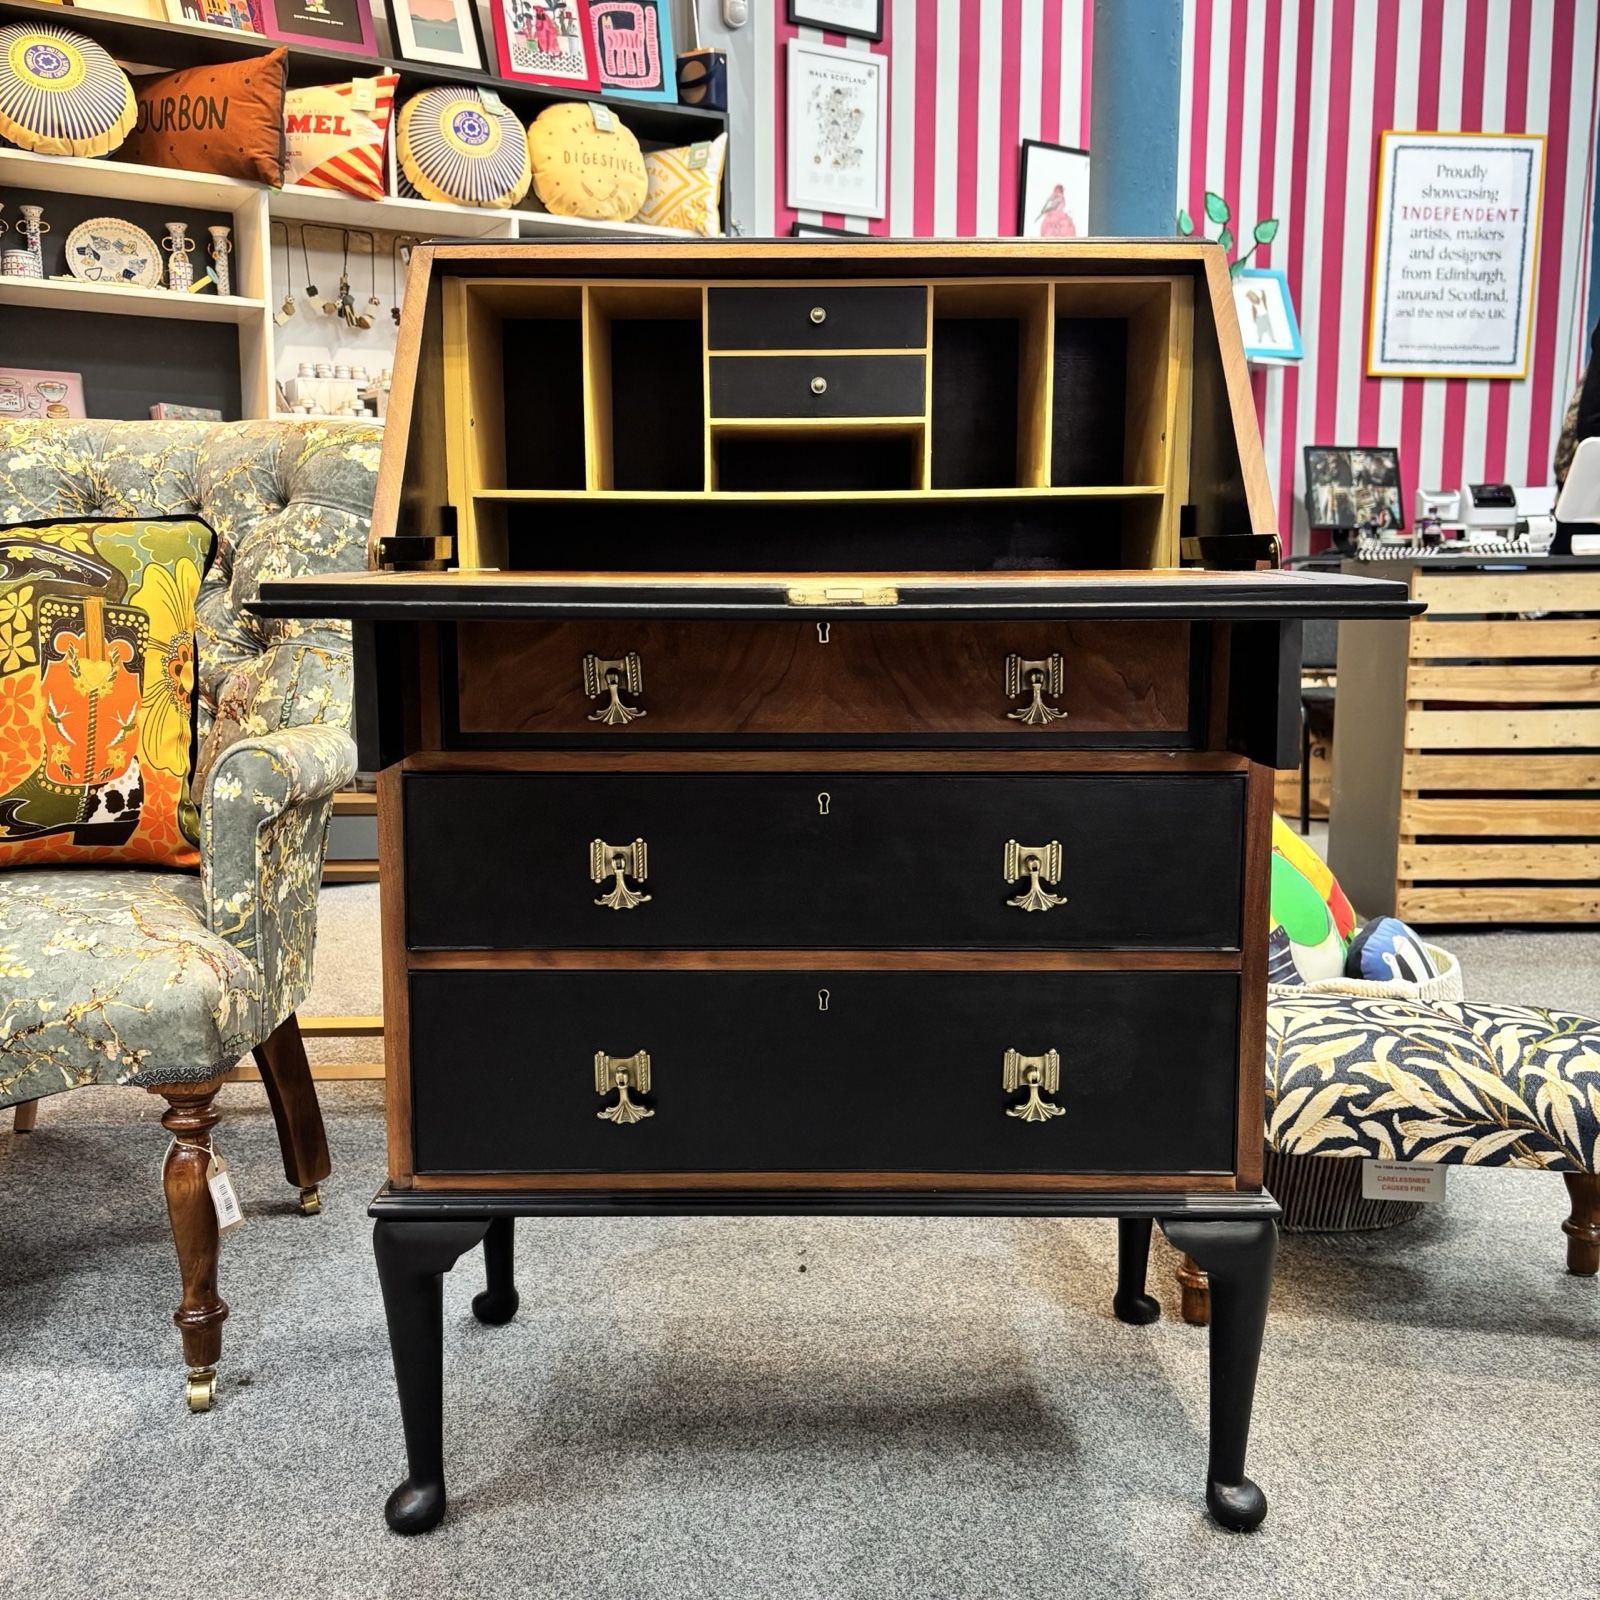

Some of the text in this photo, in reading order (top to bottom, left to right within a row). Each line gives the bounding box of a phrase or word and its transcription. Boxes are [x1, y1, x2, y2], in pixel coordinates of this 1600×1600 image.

[831, 73, 868, 85] SCOTLAND
[136, 94, 229, 134] OURBON
[286, 114, 351, 137] MEL
[563, 150, 634, 174] DIGESTIVE
[1436, 164, 1488, 182] Proudly
[1421, 184, 1500, 204] showcasing
[1401, 205, 1520, 222] INDEPENDENT
[1409, 226, 1505, 240] artists, makers
[1409, 245, 1502, 264] and designers
[1401, 265, 1506, 286] from Edinburgh,
[1396, 286, 1509, 303] around Scotland,
[1395, 306, 1415, 318] and
[1417, 307, 1434, 318] the
[1436, 308, 1454, 319] rest
[1456, 308, 1468, 319] of
[1469, 308, 1486, 319] the
[1376, 1175, 1431, 1184] CARELESSNESS
[1381, 1184, 1426, 1193] CAUSES FIRE
